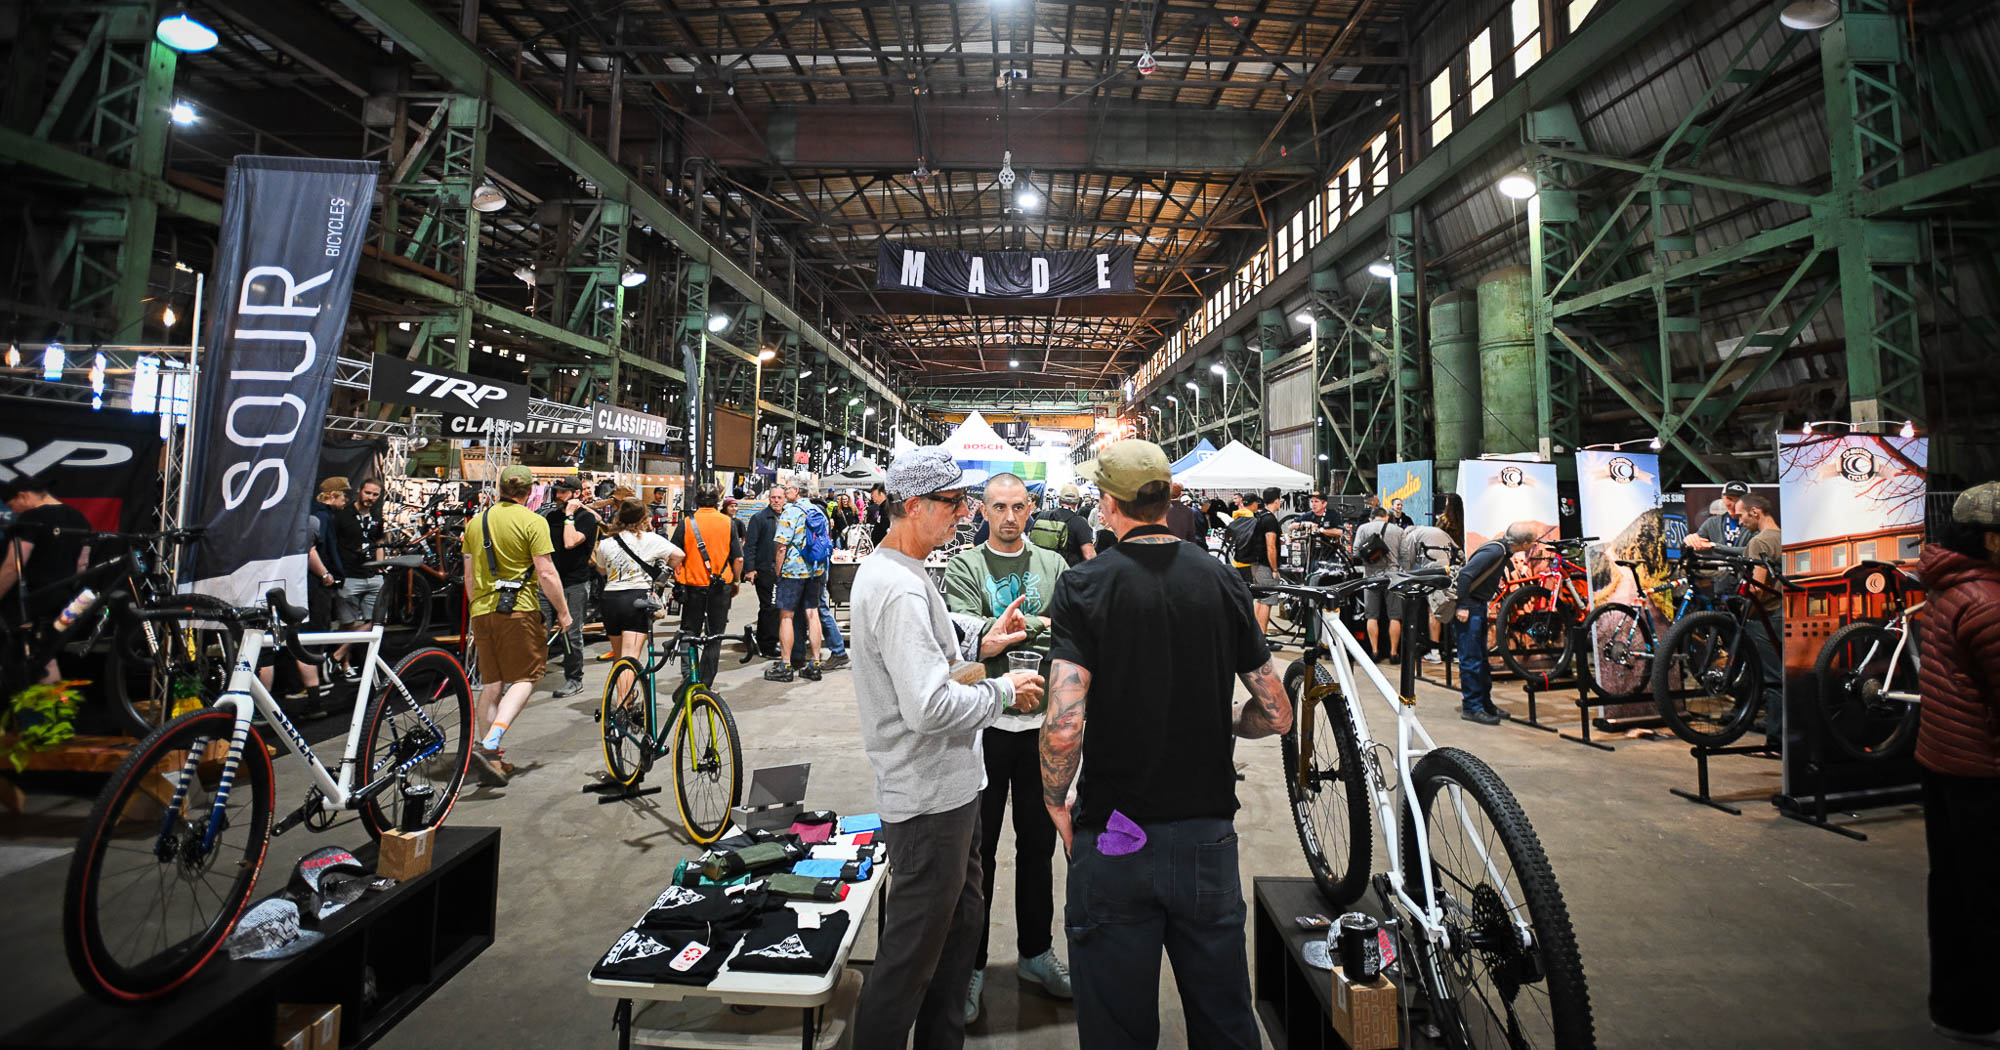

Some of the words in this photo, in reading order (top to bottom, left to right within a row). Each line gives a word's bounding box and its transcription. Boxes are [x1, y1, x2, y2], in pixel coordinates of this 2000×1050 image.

[325, 198, 346, 257] BICYCLES
[222, 265, 334, 511] SOUR
[406, 370, 508, 409] TRP
[598, 408, 663, 438] CLASSIFIED
[963, 443, 1003, 451] BOSCH
[271, 710, 315, 766] SEEKER
